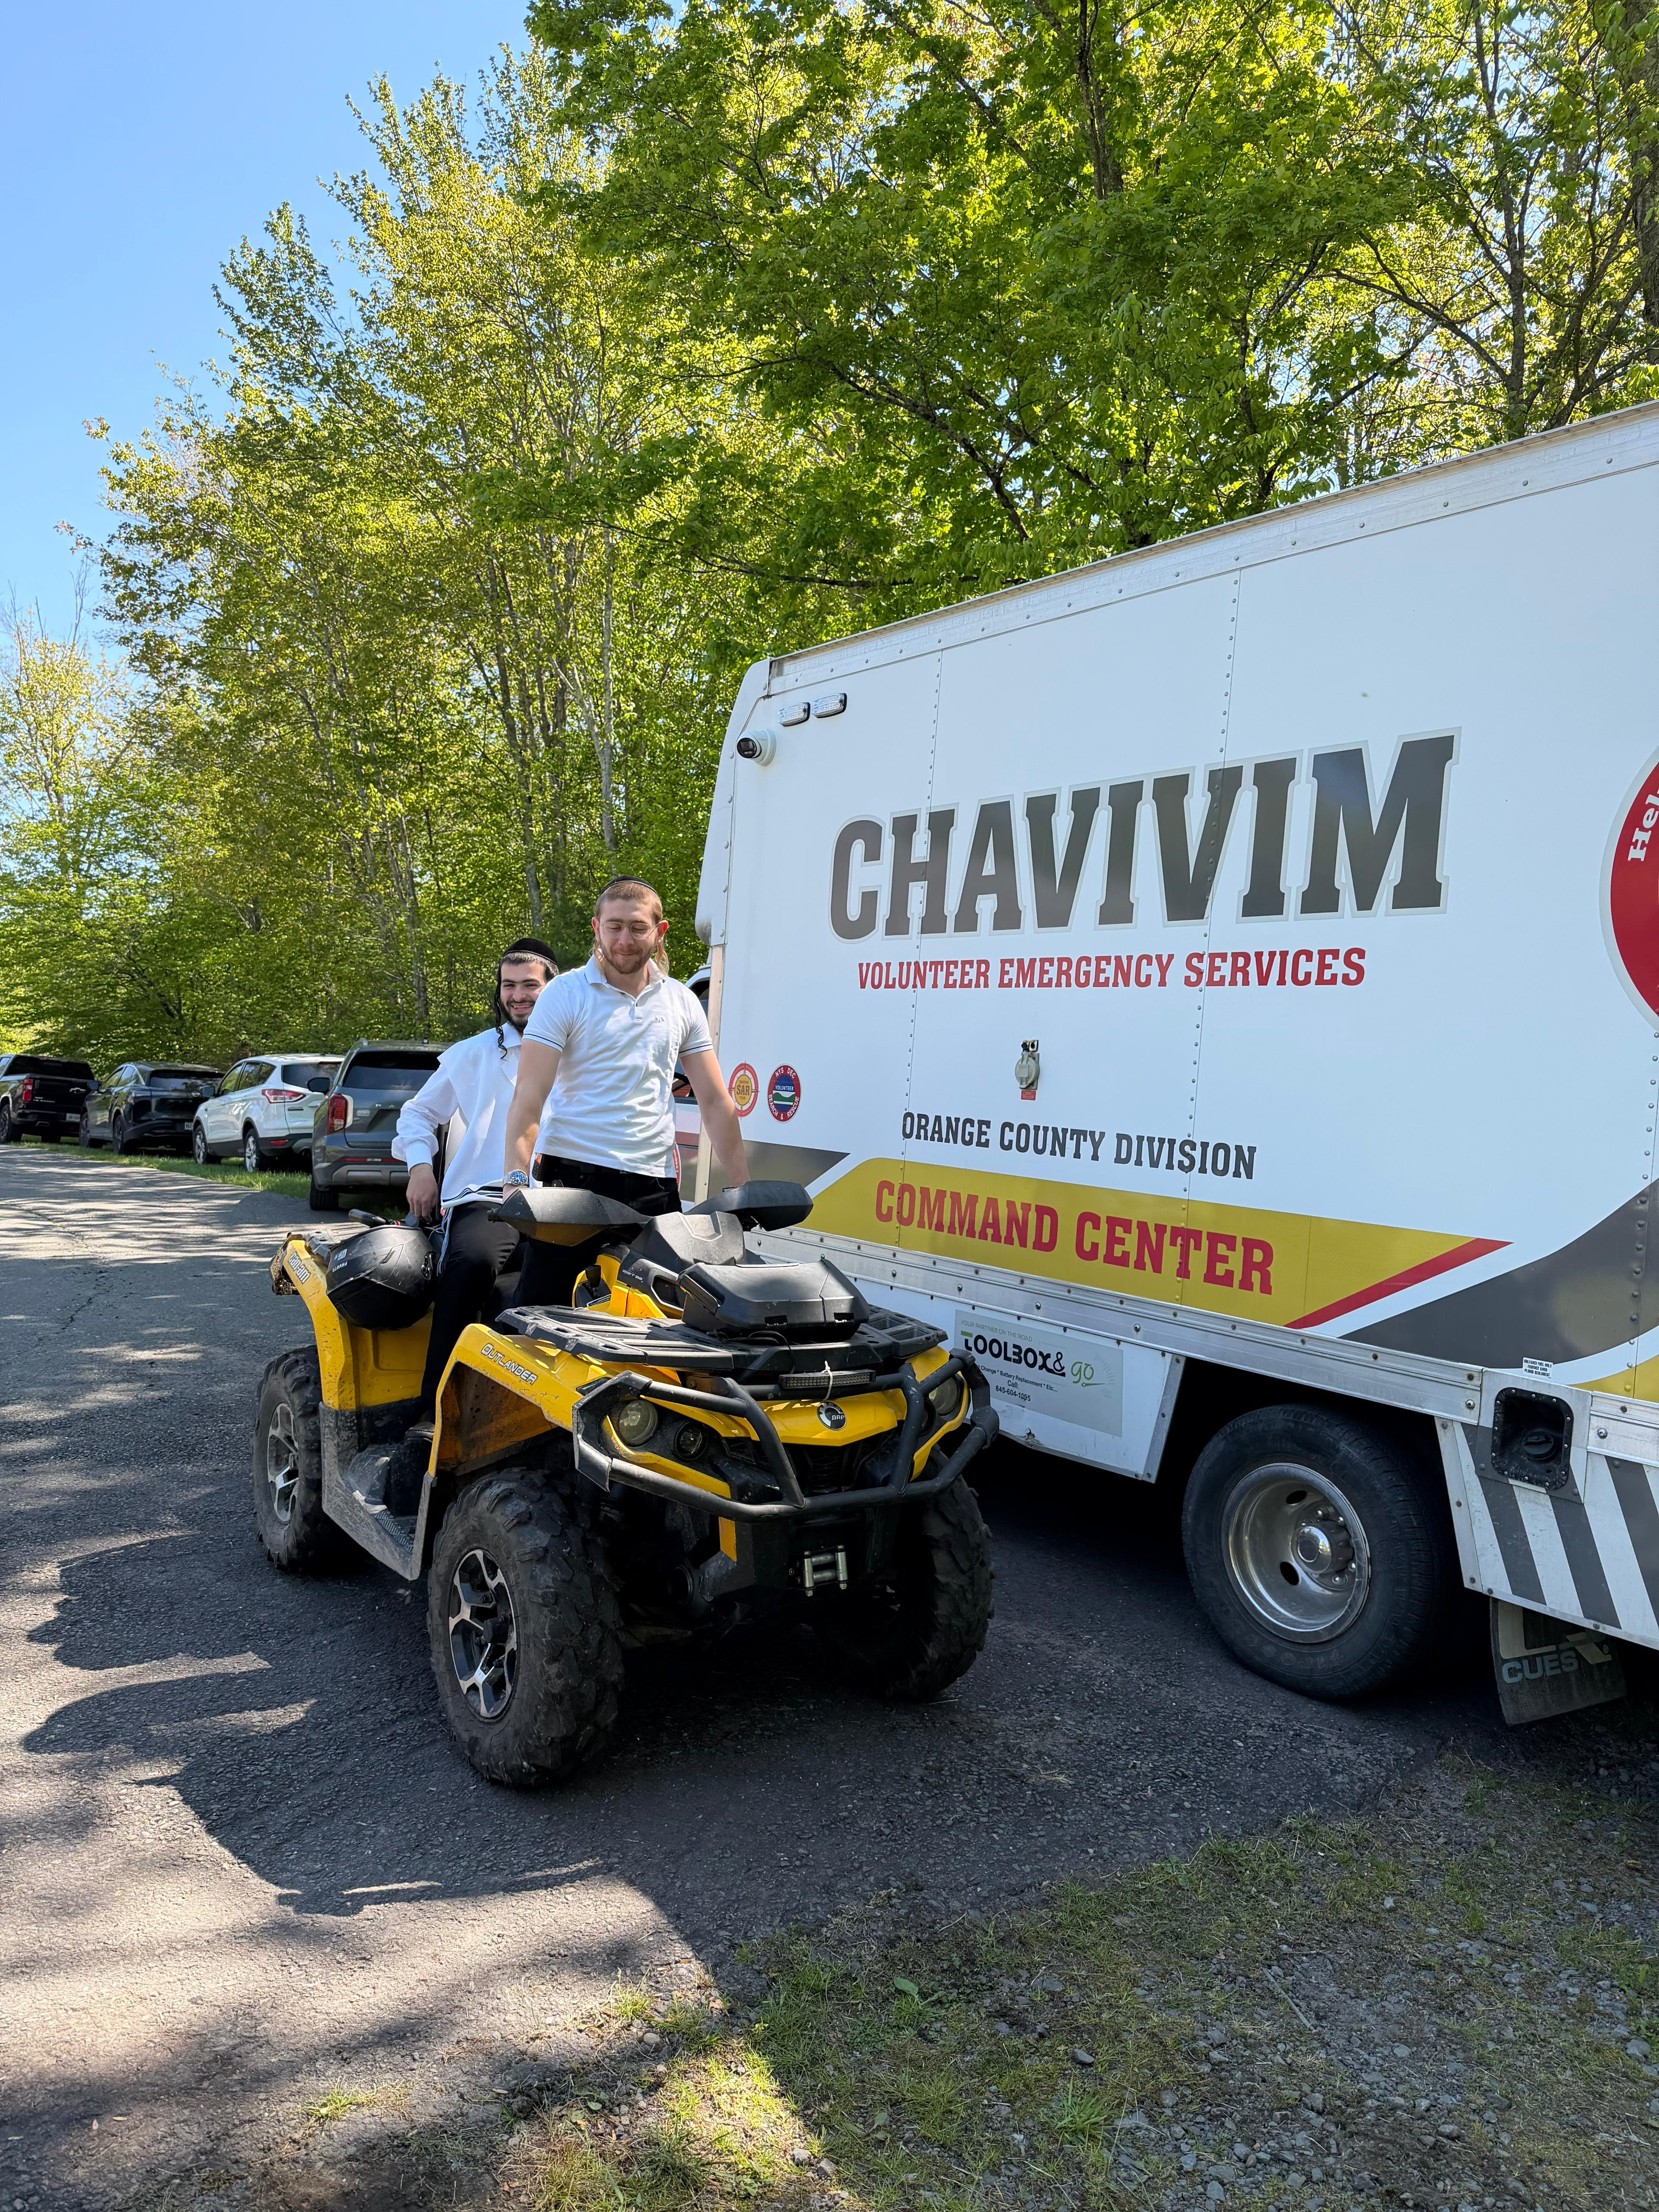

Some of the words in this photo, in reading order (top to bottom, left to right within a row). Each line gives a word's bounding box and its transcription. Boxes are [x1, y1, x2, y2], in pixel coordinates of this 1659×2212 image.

[830, 734, 1455, 941] CHAVIVIM
[858, 959, 990, 989] VOLUNTEER
[997, 953, 1175, 989] EMERGENCY
[1184, 947, 1366, 987] SERVICES
[775, 1067, 784, 1077] NYS
[787, 1068, 795, 1078] DEC
[736, 1084, 750, 1096] SAR
[769, 1094, 778, 1117] SEARCH
[786, 1096, 800, 1118] RESCUE
[902, 1111, 991, 1148] ORANGE
[999, 1121, 1106, 1162] COUNTY
[1114, 1133, 1257, 1180] DIVISION
[875, 1179, 1059, 1253] COMMAND
[1075, 1211, 1274, 1295] CENTER
[961, 1319, 975, 1327] YOUR
[975, 1323, 998, 1334] PARTNER
[1018, 1334, 1033, 1342] ROAD
[480, 1343, 538, 1385] OUTLANDER
[1070, 1361, 1095, 1384] go
[1000, 1370, 1015, 1380] Battery
[1015, 1375, 1042, 1388] Replacement
[1007, 1380, 1019, 1389] Call:
[1502, 1650, 1579, 1684] CUES
